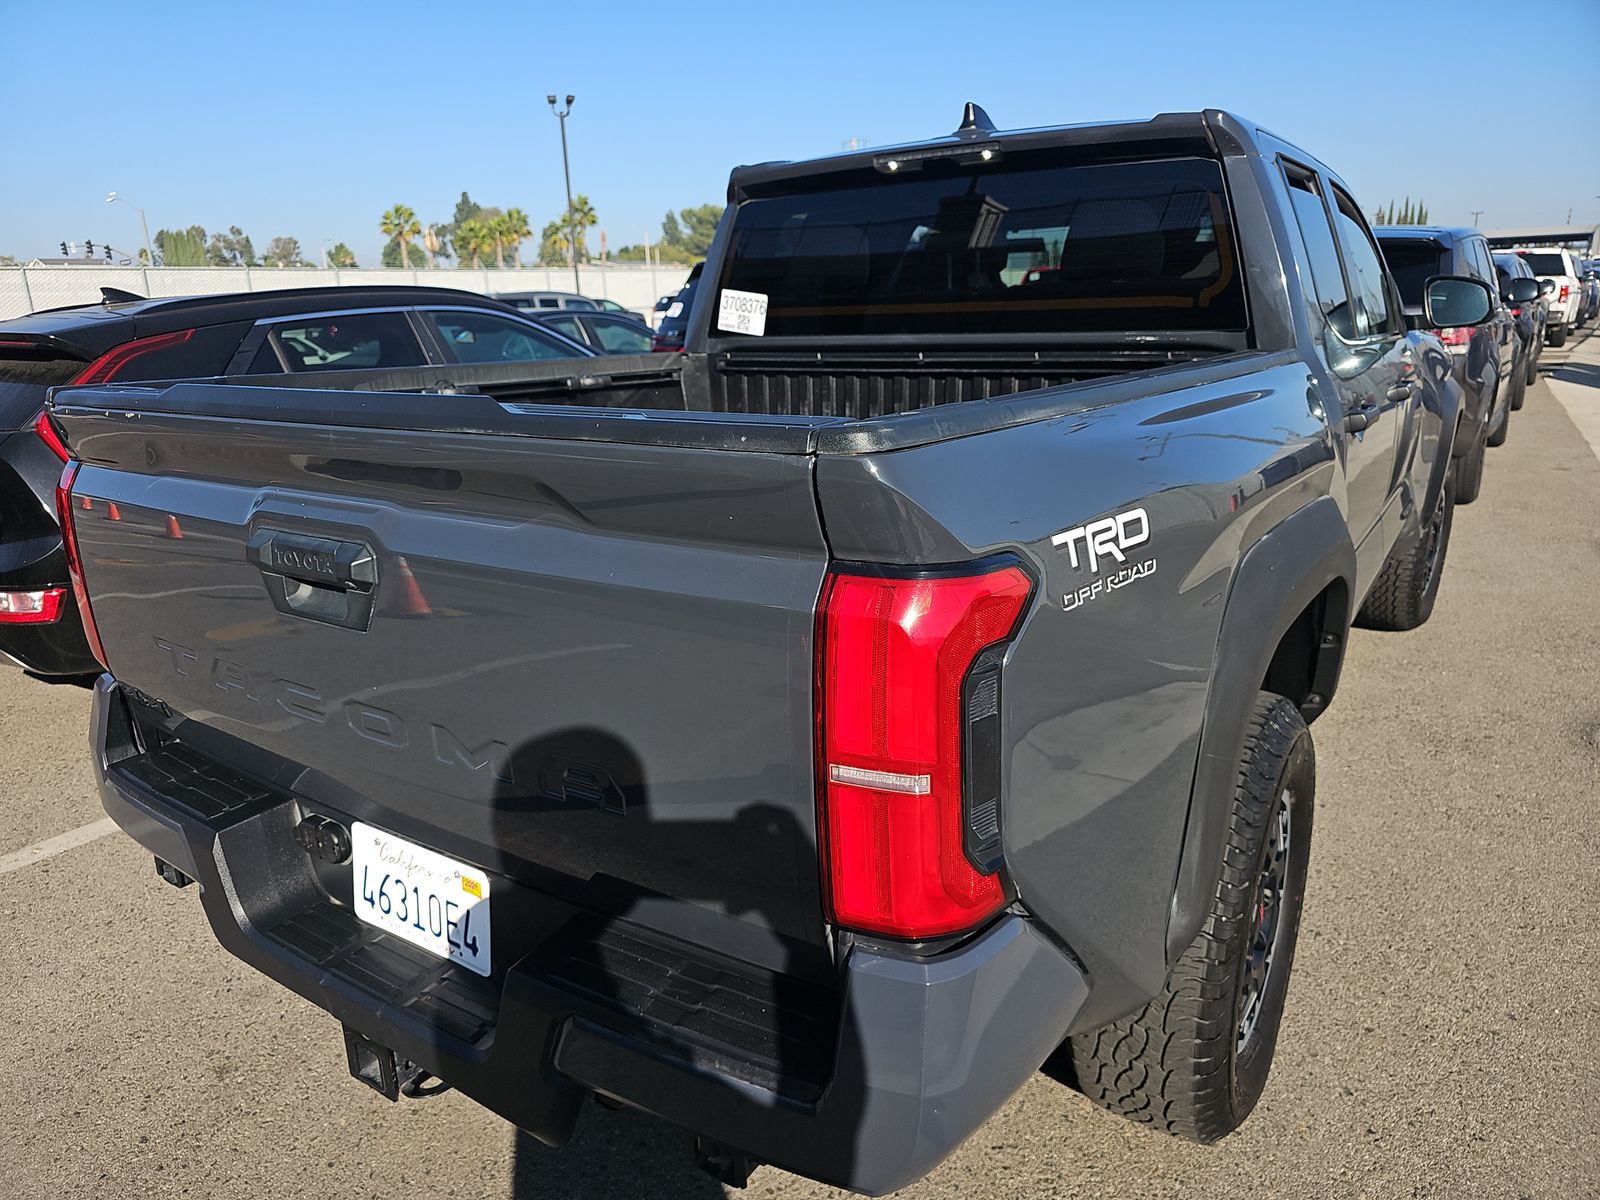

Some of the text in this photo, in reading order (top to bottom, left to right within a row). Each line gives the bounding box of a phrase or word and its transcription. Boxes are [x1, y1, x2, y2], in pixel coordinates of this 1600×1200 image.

[722, 295, 767, 315] 3708376
[274, 547, 334, 575] TOYOTA
[1051, 507, 1150, 573] TRD
[1062, 558, 1157, 612] OFF ROAD
[152, 635, 627, 816] TACOMA
[363, 864, 479, 958] 46310E4
